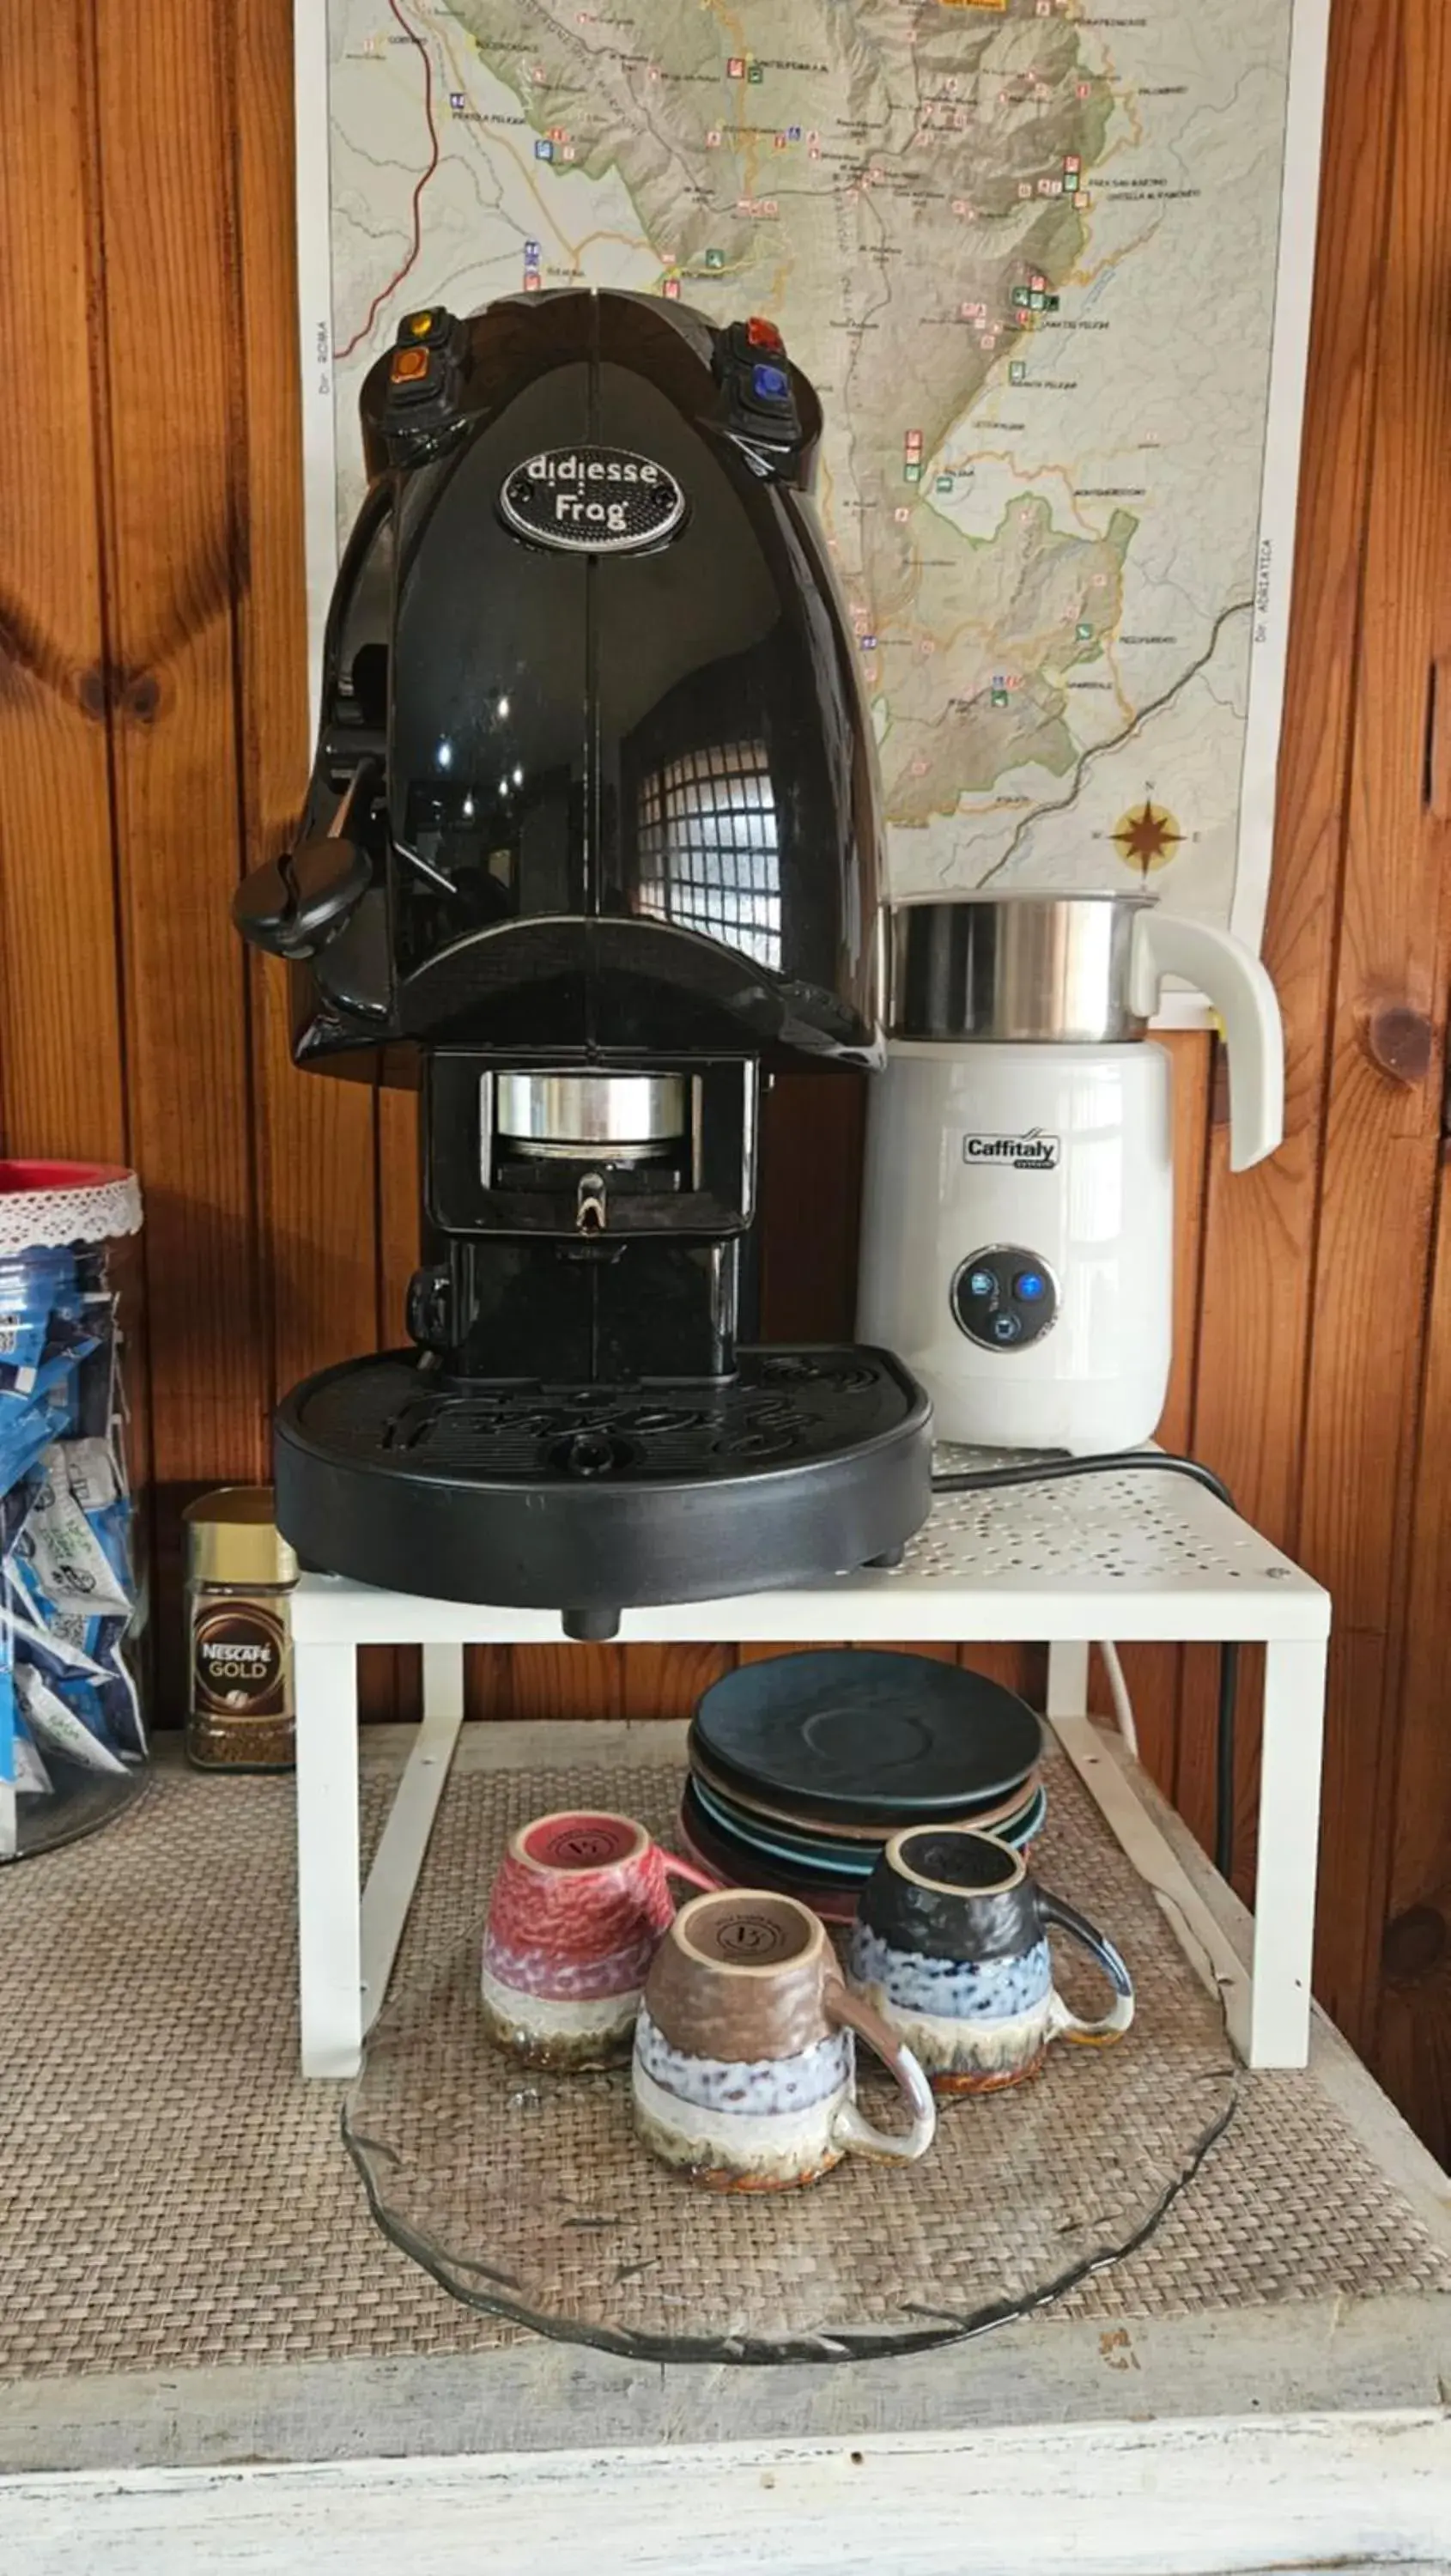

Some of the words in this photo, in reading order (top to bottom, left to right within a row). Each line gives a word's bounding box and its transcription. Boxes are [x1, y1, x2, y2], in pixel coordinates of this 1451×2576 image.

[527, 455, 659, 487] didiesse
[556, 494, 628, 531] Frog
[1257, 539, 1272, 614] ADRIATICA
[968, 1139, 1055, 1162] Caffitaly
[203, 1642, 271, 1662] NESCAFÉ
[209, 1661, 267, 1679] GOLD
